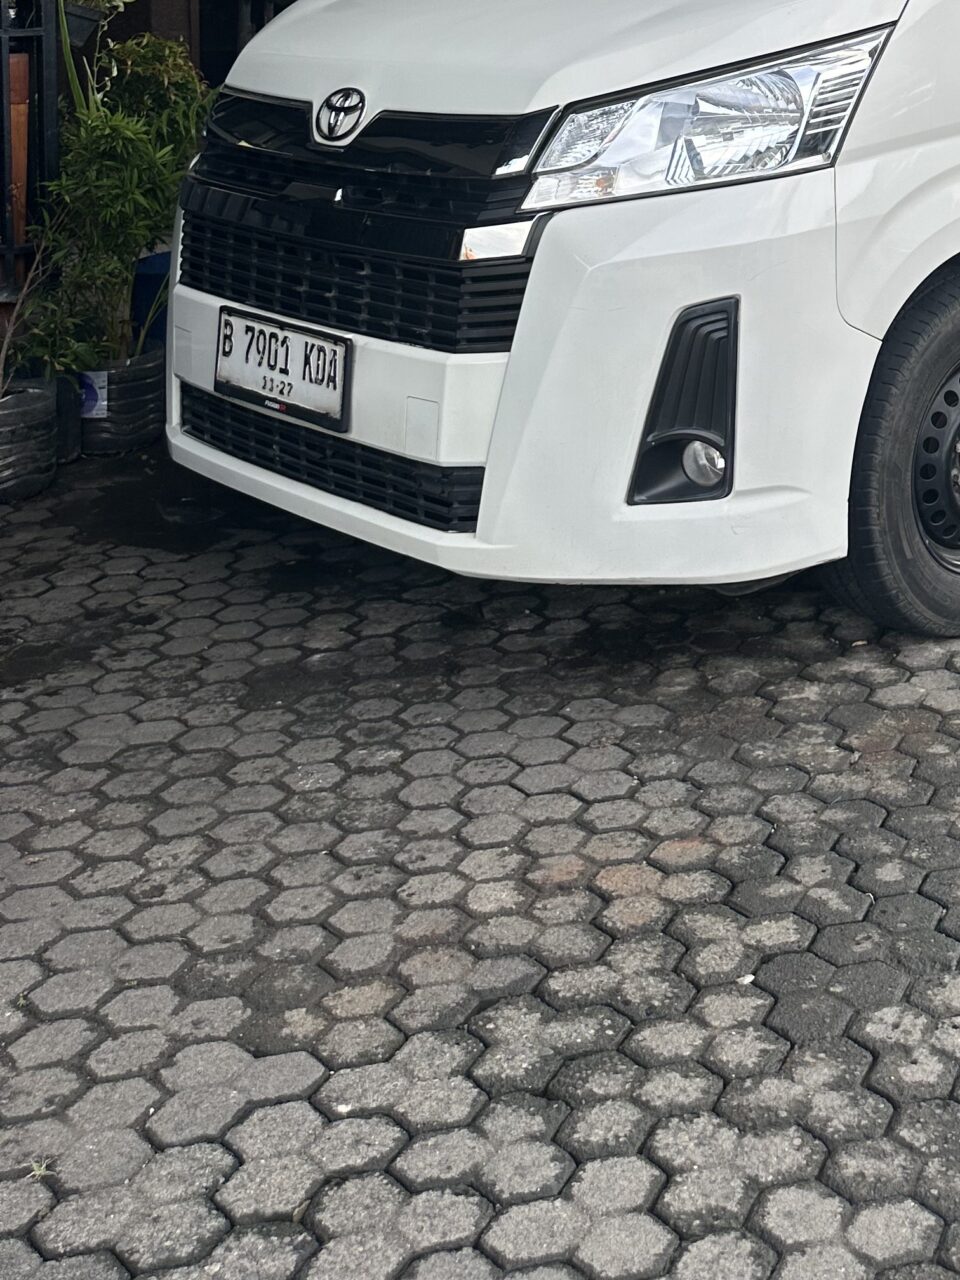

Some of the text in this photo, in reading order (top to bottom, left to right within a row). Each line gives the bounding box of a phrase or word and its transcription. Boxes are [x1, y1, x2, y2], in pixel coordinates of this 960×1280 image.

[222, 318, 338, 391] B 7901 KDA
